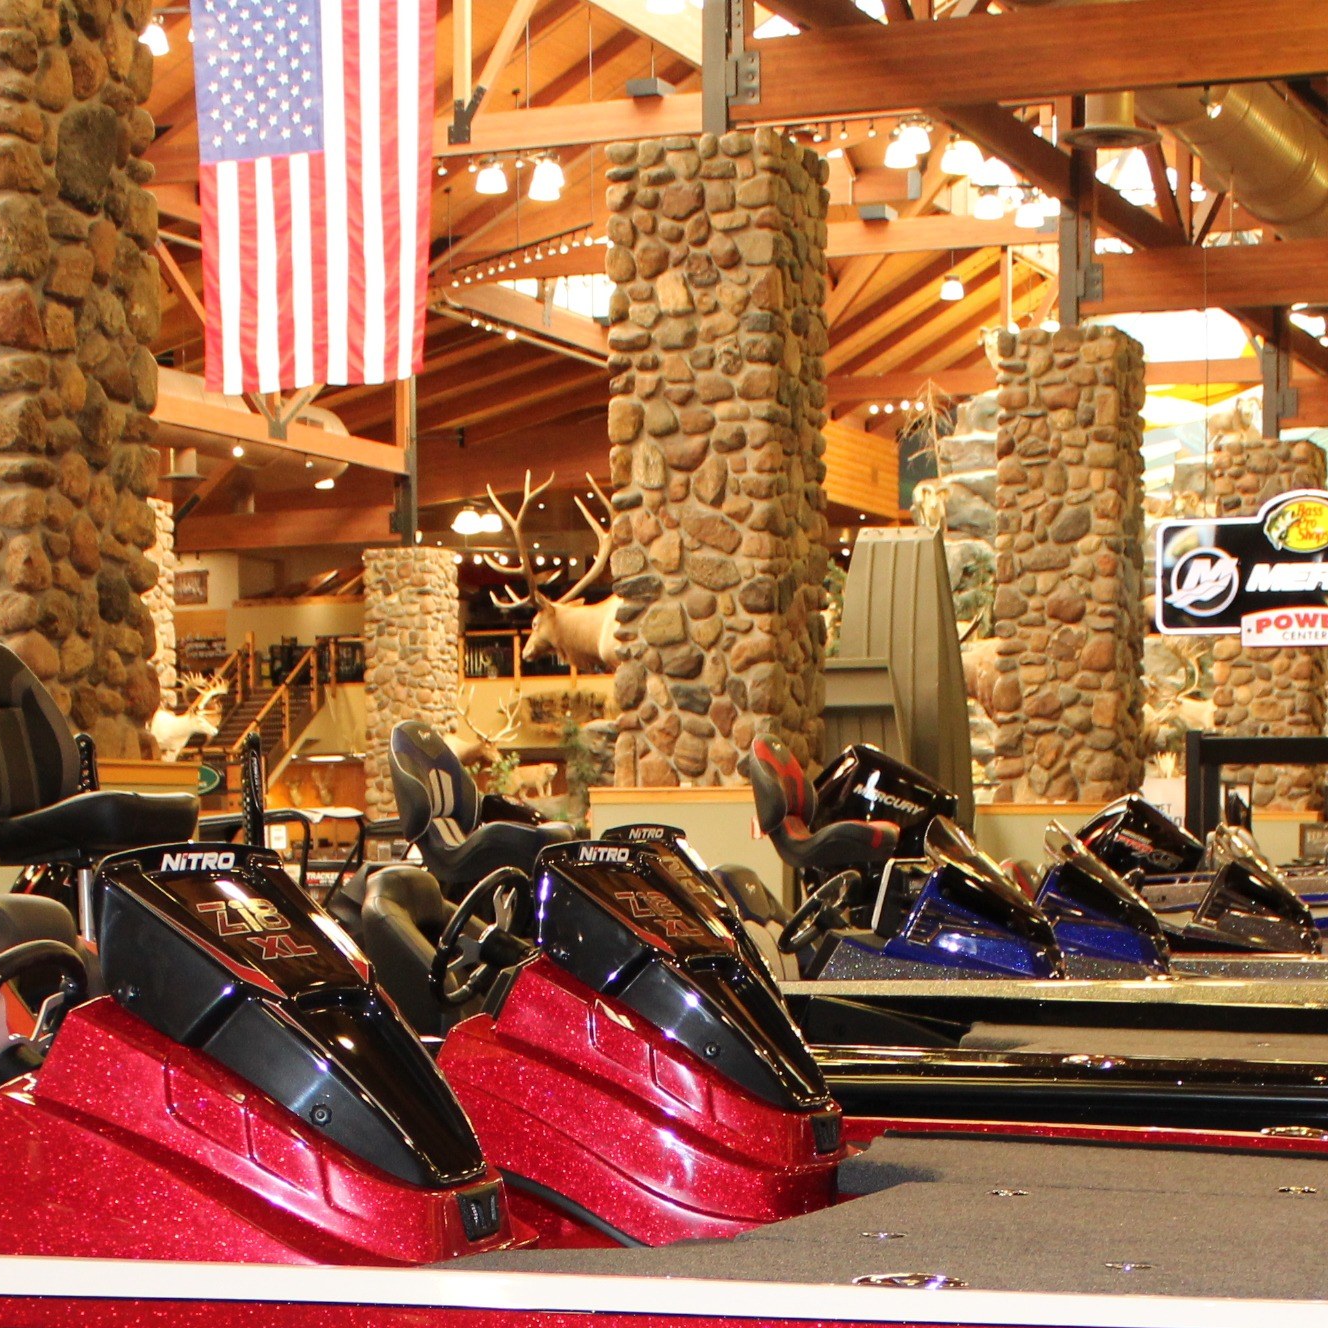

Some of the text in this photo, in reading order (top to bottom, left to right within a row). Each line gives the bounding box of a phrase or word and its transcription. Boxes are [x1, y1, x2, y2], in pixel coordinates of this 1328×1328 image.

[1297, 504, 1323, 517] Bass
[1298, 518, 1318, 529] Pro
[1282, 630, 1328, 641] CENTER
[196, 898, 292, 937] Z18
[654, 919, 704, 937] XL
[247, 935, 318, 960] XL
